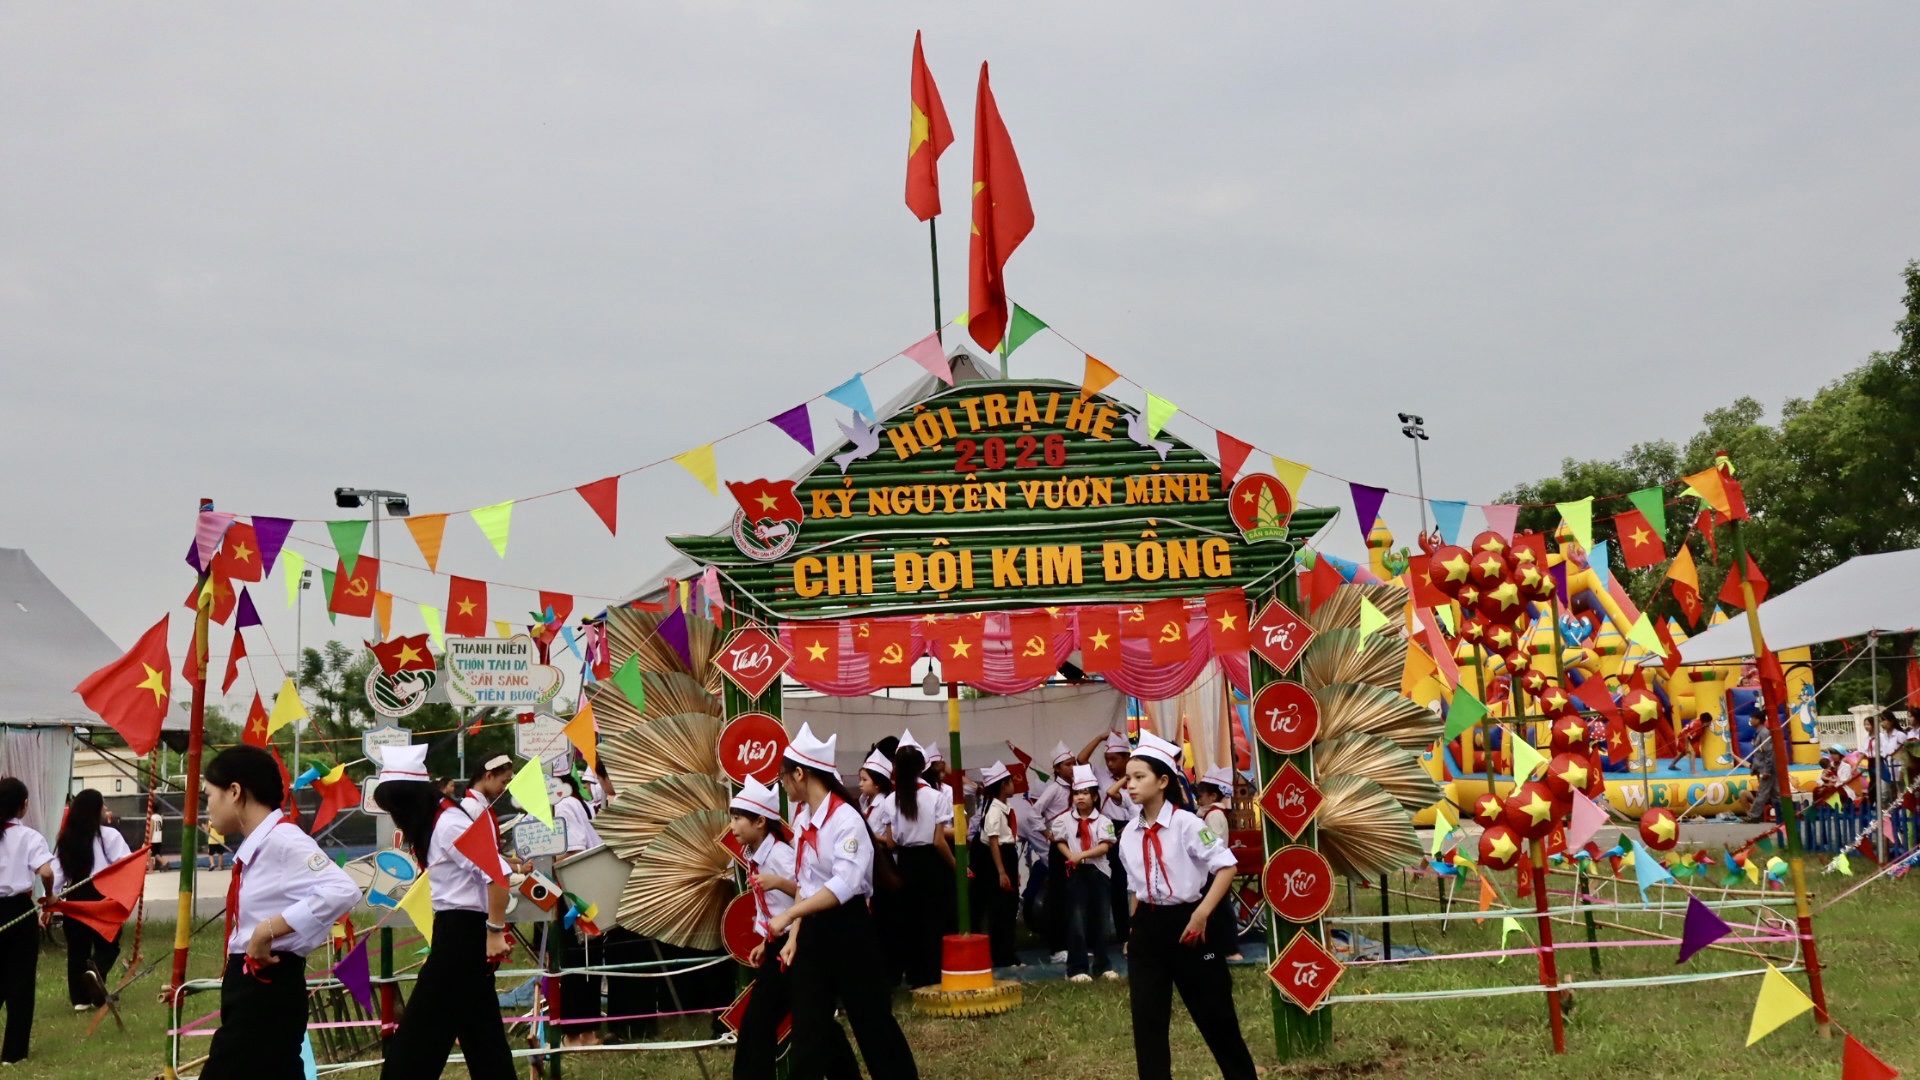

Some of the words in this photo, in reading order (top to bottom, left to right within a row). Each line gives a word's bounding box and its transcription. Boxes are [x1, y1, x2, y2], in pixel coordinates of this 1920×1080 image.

[886, 405, 958, 461] HỘI
[959, 390, 1061, 431] TRẠI
[1065, 397, 1119, 442] HÈ
[954, 433, 1067, 472] 2026
[810, 476, 857, 519] KỶ
[867, 473, 1007, 516] NGUYÊN
[1018, 475, 1114, 509] VƯƠN
[793, 553, 874, 598] CHI
[893, 537, 974, 599] ĐỘI
[991, 544, 1084, 588] KIM
[1101, 519, 1232, 582] ĐỒNG
[452, 643, 492, 655] THANH
[456, 657, 485, 670] THÔN
[487, 659, 511, 670] TAM
